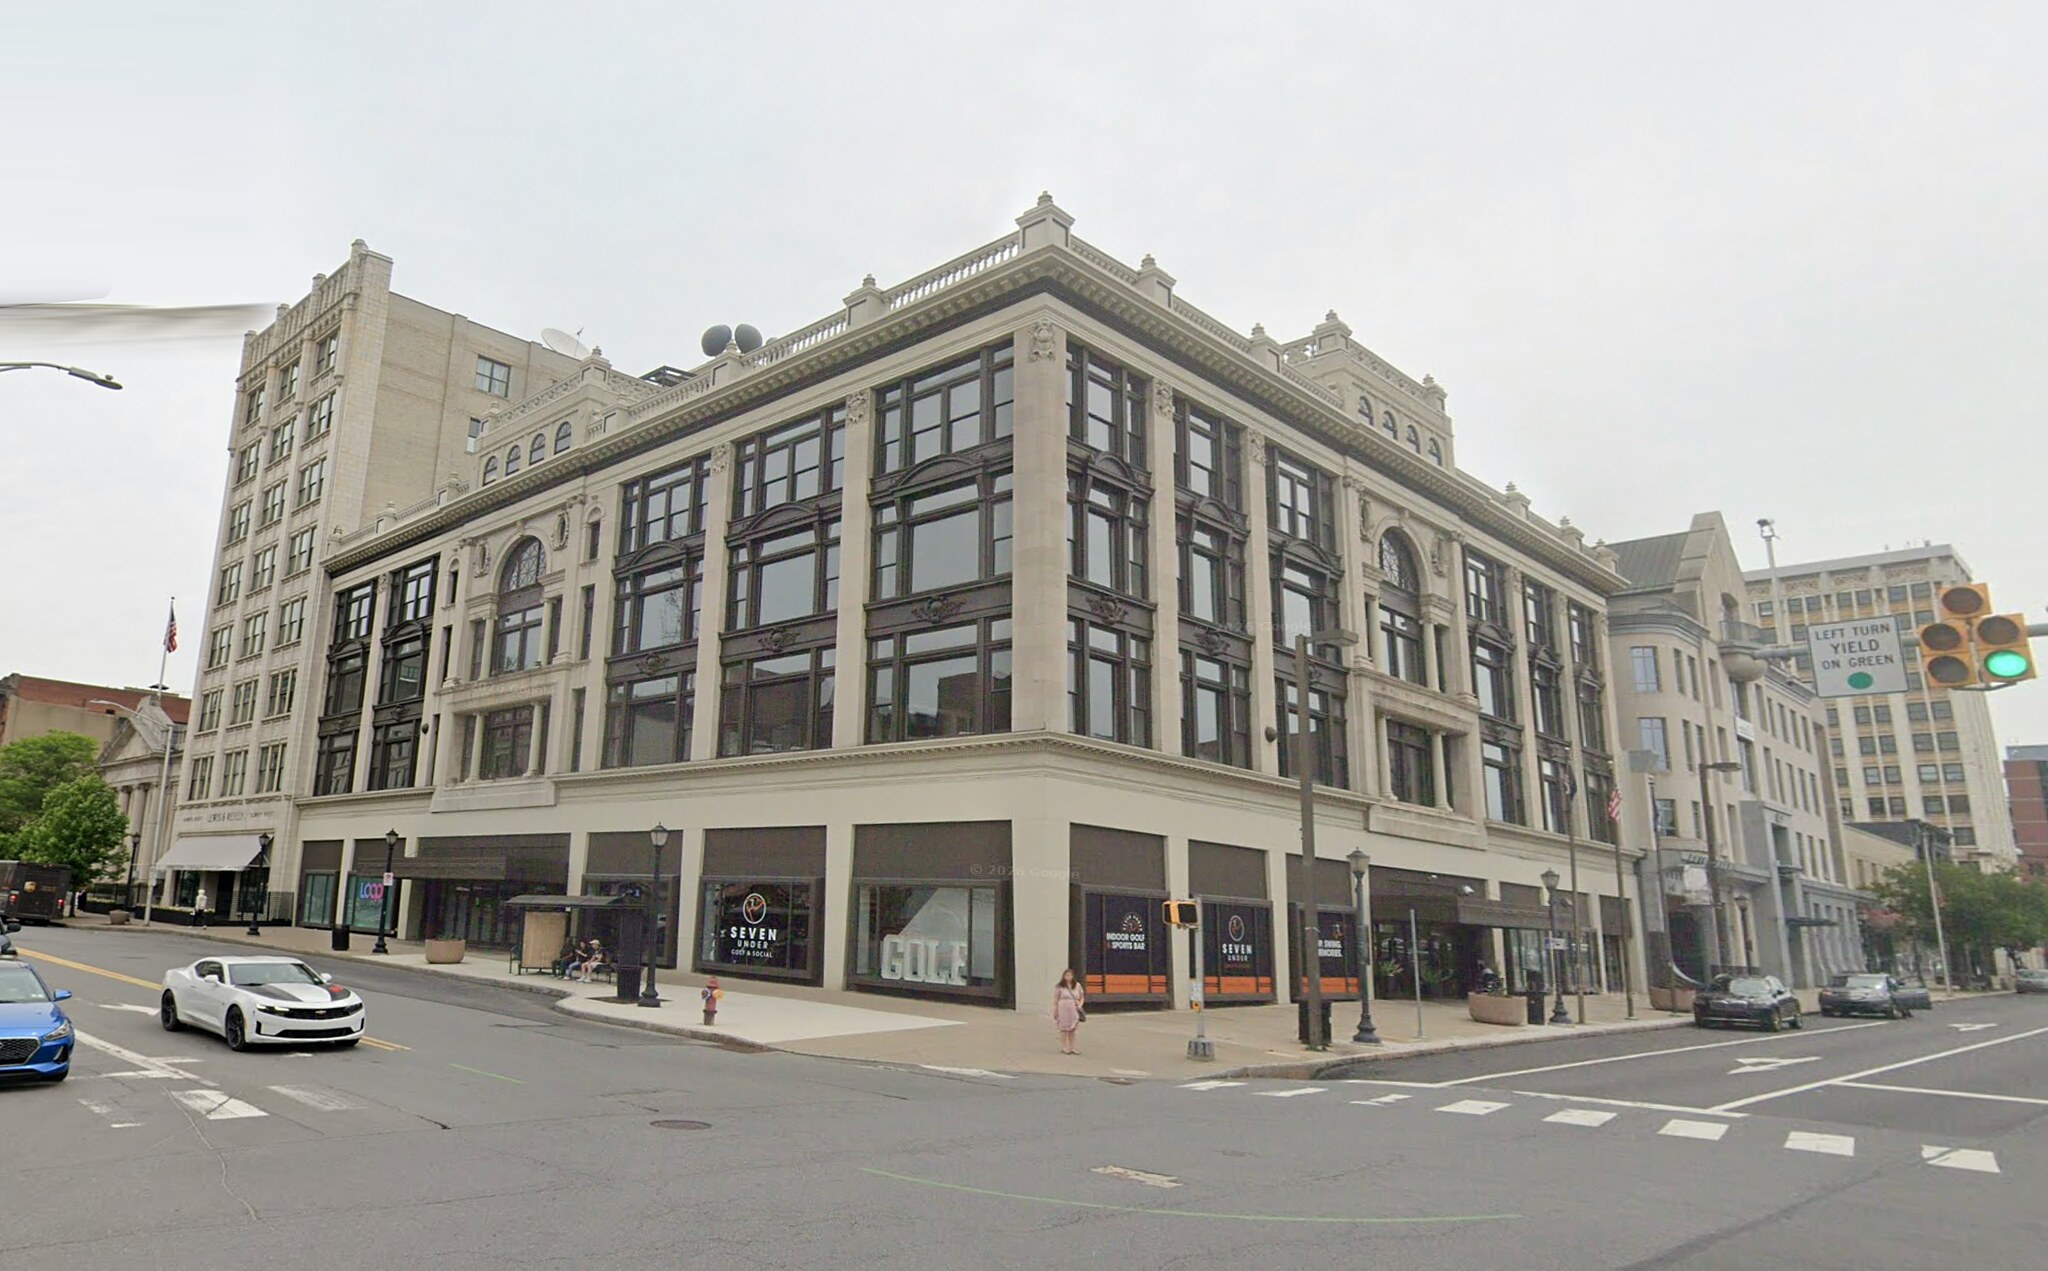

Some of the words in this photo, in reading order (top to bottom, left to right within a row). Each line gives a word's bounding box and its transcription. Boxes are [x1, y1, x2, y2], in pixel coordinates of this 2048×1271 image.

[1815, 628, 1845, 641] LEFT
[1852, 623, 1890, 636] TURN
[1830, 639, 1880, 655] YIELD
[1821, 659, 1841, 670] ON
[1848, 654, 1894, 668] GREEN
[730, 926, 777, 941] SEVEN
[1106, 932, 1129, 941] INDOOR
[1130, 933, 1145, 942] GOLF
[737, 940, 769, 949] UNDER
[1111, 941, 1132, 950] SPORTS
[1133, 941, 1146, 950] BAR
[1222, 943, 1253, 955] SEVEN
[752, 950, 773, 958] SOCIAL
[881, 934, 969, 987] GOLF
